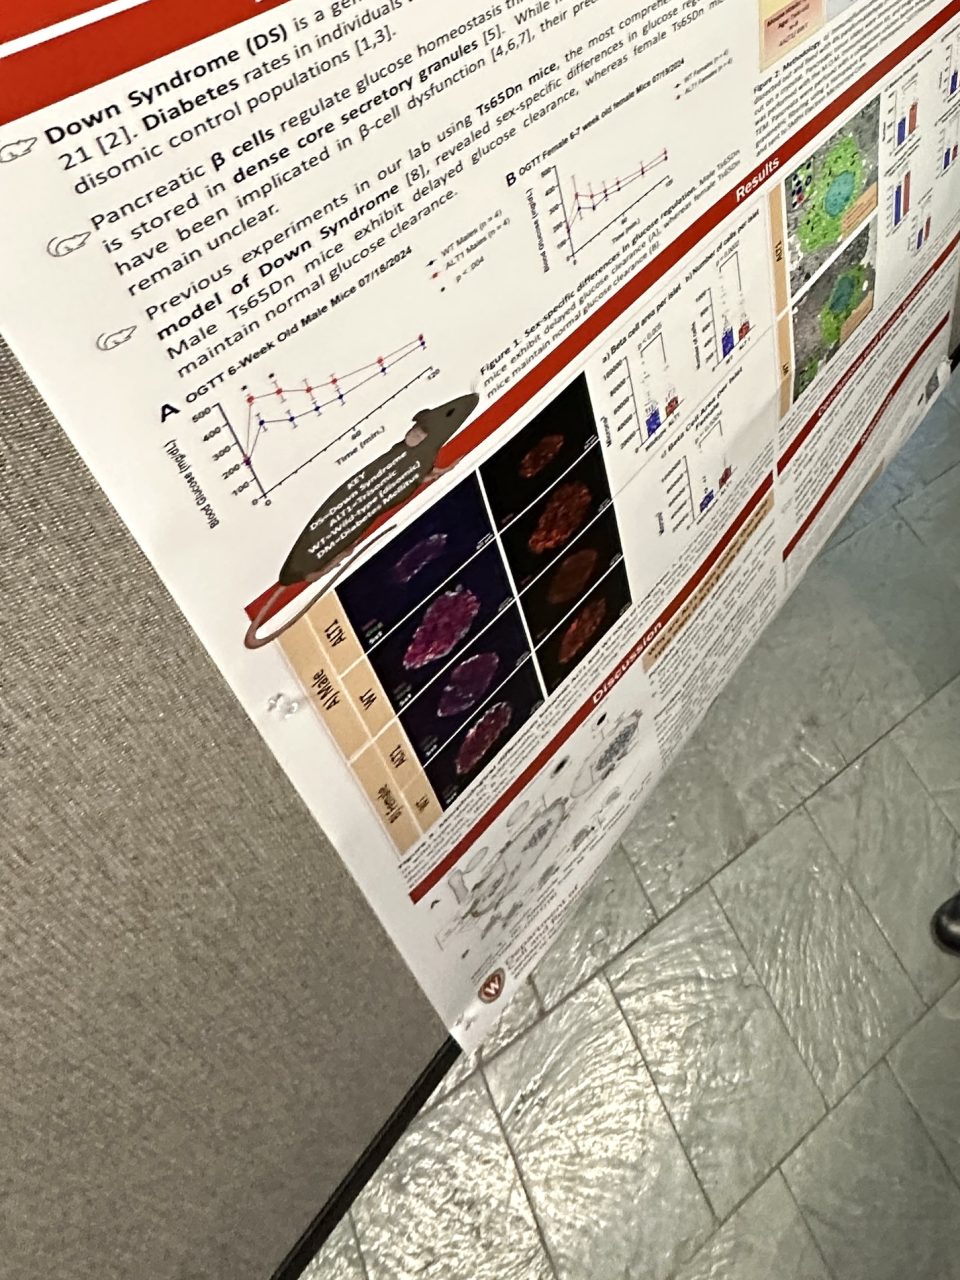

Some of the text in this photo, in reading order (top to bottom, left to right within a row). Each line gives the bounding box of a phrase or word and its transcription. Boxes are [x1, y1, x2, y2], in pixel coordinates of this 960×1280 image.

[43, 103, 121, 145] Down
[127, 49, 240, 108] Syndrome
[245, 23, 287, 56] (DS)
[293, 16, 308, 31] is
[313, 9, 325, 22] a
[58, 145, 92, 171] 21
[94, 125, 137, 156] [2].
[141, 77, 239, 131] Diabetes
[243, 53, 291, 83] rates
[293, 42, 312, 59] in
[73, 23, 396, 194] disomic control populations [1,3].
[89, 164, 205, 231] Pancreatic
[231, 128, 275, 157] cells
[279, 87, 351, 132] regulate
[355, 53, 413, 94] glucose
[416, 4, 502, 57] homeostasis
[101, 237, 123, 253] is
[130, 191, 199, 240] stored
[205, 182, 226, 198] in
[232, 146, 290, 184] dense
[296, 121, 335, 149] core
[340, 75, 412, 125] secretory
[418, 39, 478, 83] granules
[513, 0, 550, 25] While
[113, 240, 168, 275] have
[175, 207, 229, 242] been
[235, 145, 330, 208] implicated
[336, 136, 353, 151] in
[406, 57, 486, 110] dysfunction
[539, 9, 567, 32] their
[735, 157, 780, 202] Results
[127, 203, 279, 296] remain unclear.
[160, 403, 181, 423] A
[185, 371, 224, 403] OGTT
[227, 341, 275, 375] 6-Week
[276, 323, 299, 342] Old
[299, 304, 328, 327] Male
[329, 285, 356, 307] Mice
[347, 471, 366, 491] KEY
[312, 668, 334, 704] Male
[324, 618, 347, 648] ALT1
[592, 621, 662, 705] Discussion
[359, 688, 377, 711] WT
